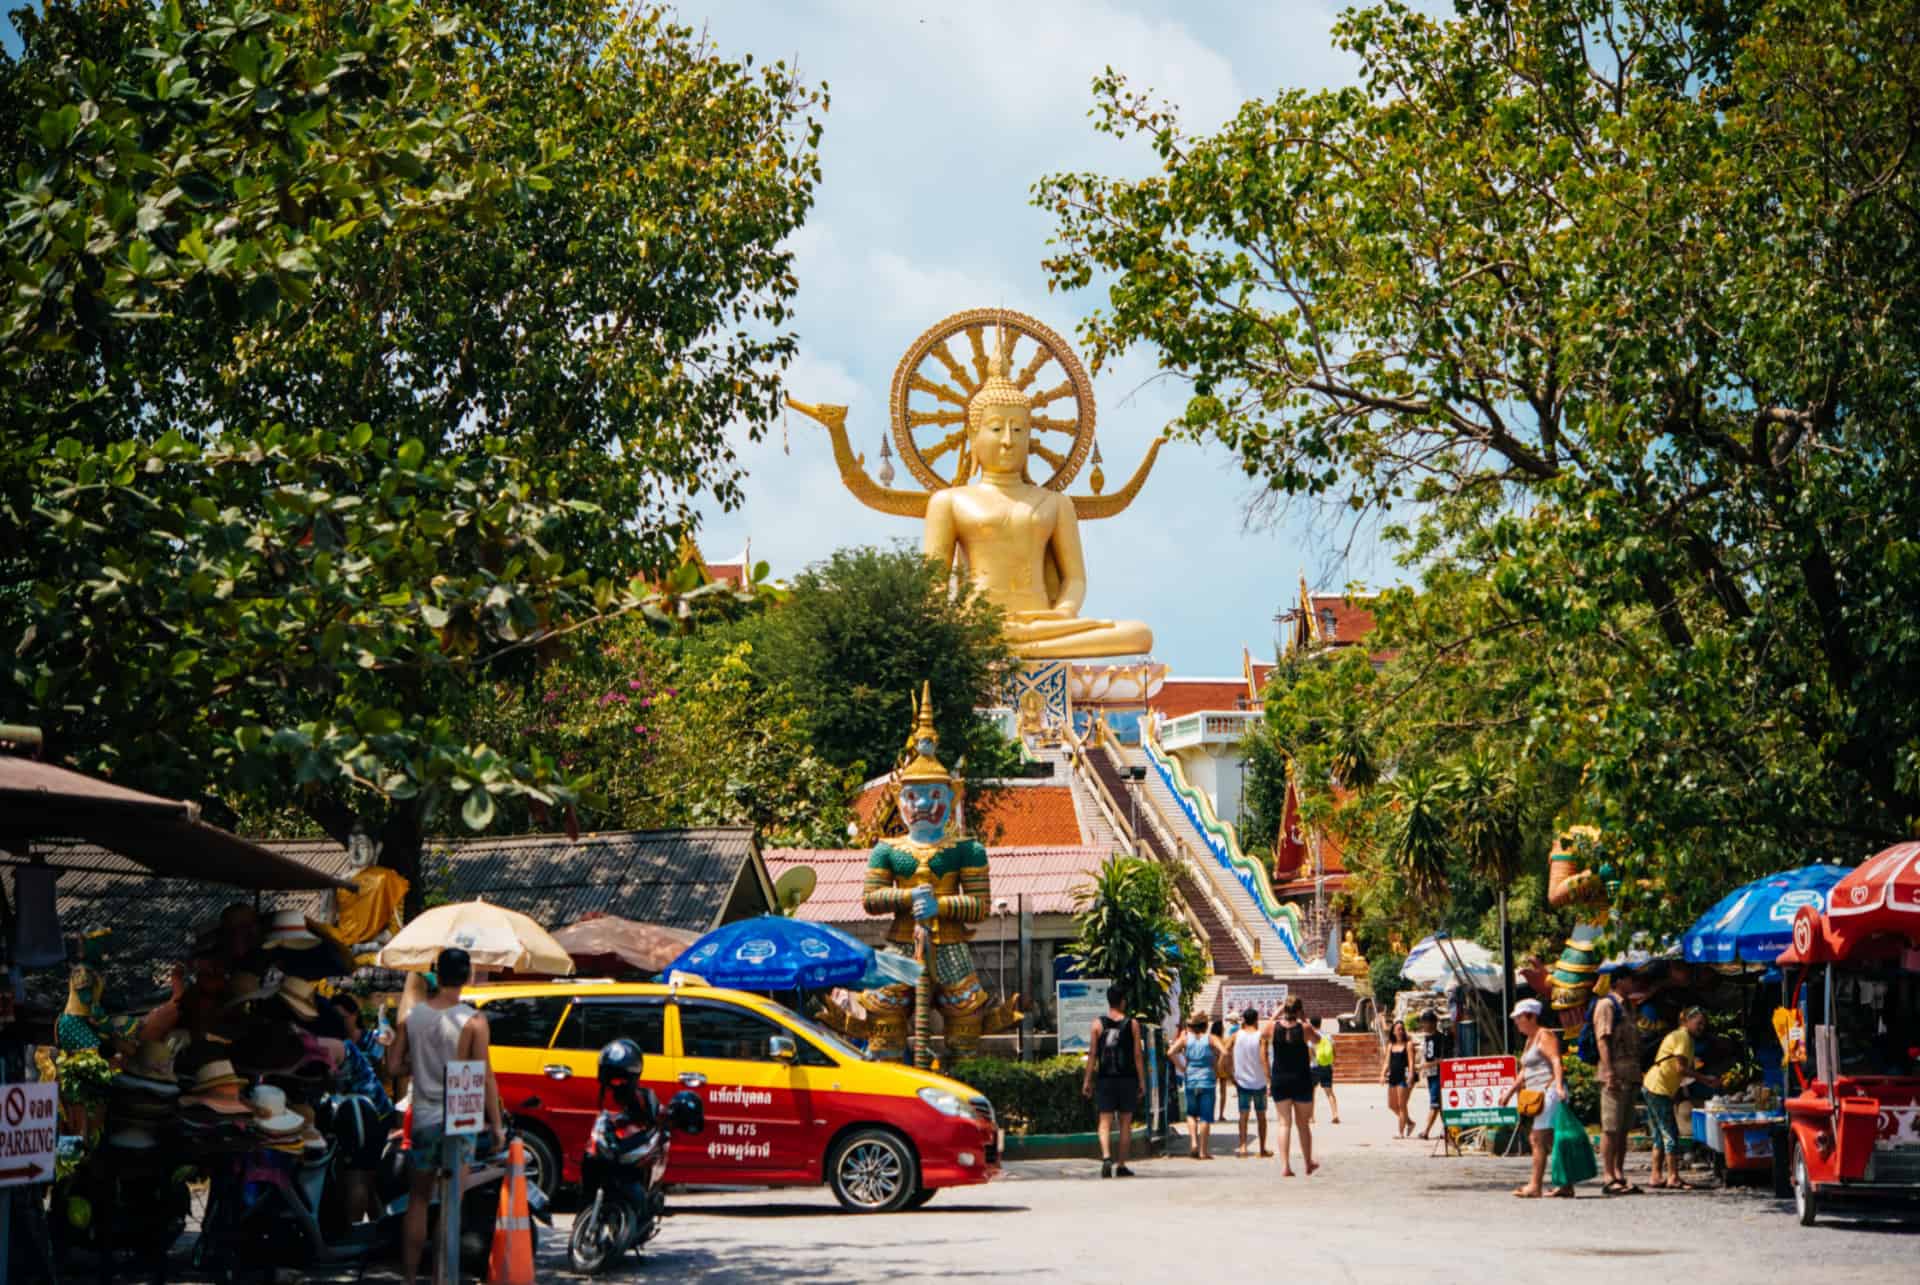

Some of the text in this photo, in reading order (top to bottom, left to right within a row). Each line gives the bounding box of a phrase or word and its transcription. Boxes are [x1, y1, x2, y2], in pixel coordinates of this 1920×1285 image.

[30, 1099, 53, 1119] จอด
[736, 1123, 757, 1136] 475
[0, 1127, 54, 1157] PARKING
